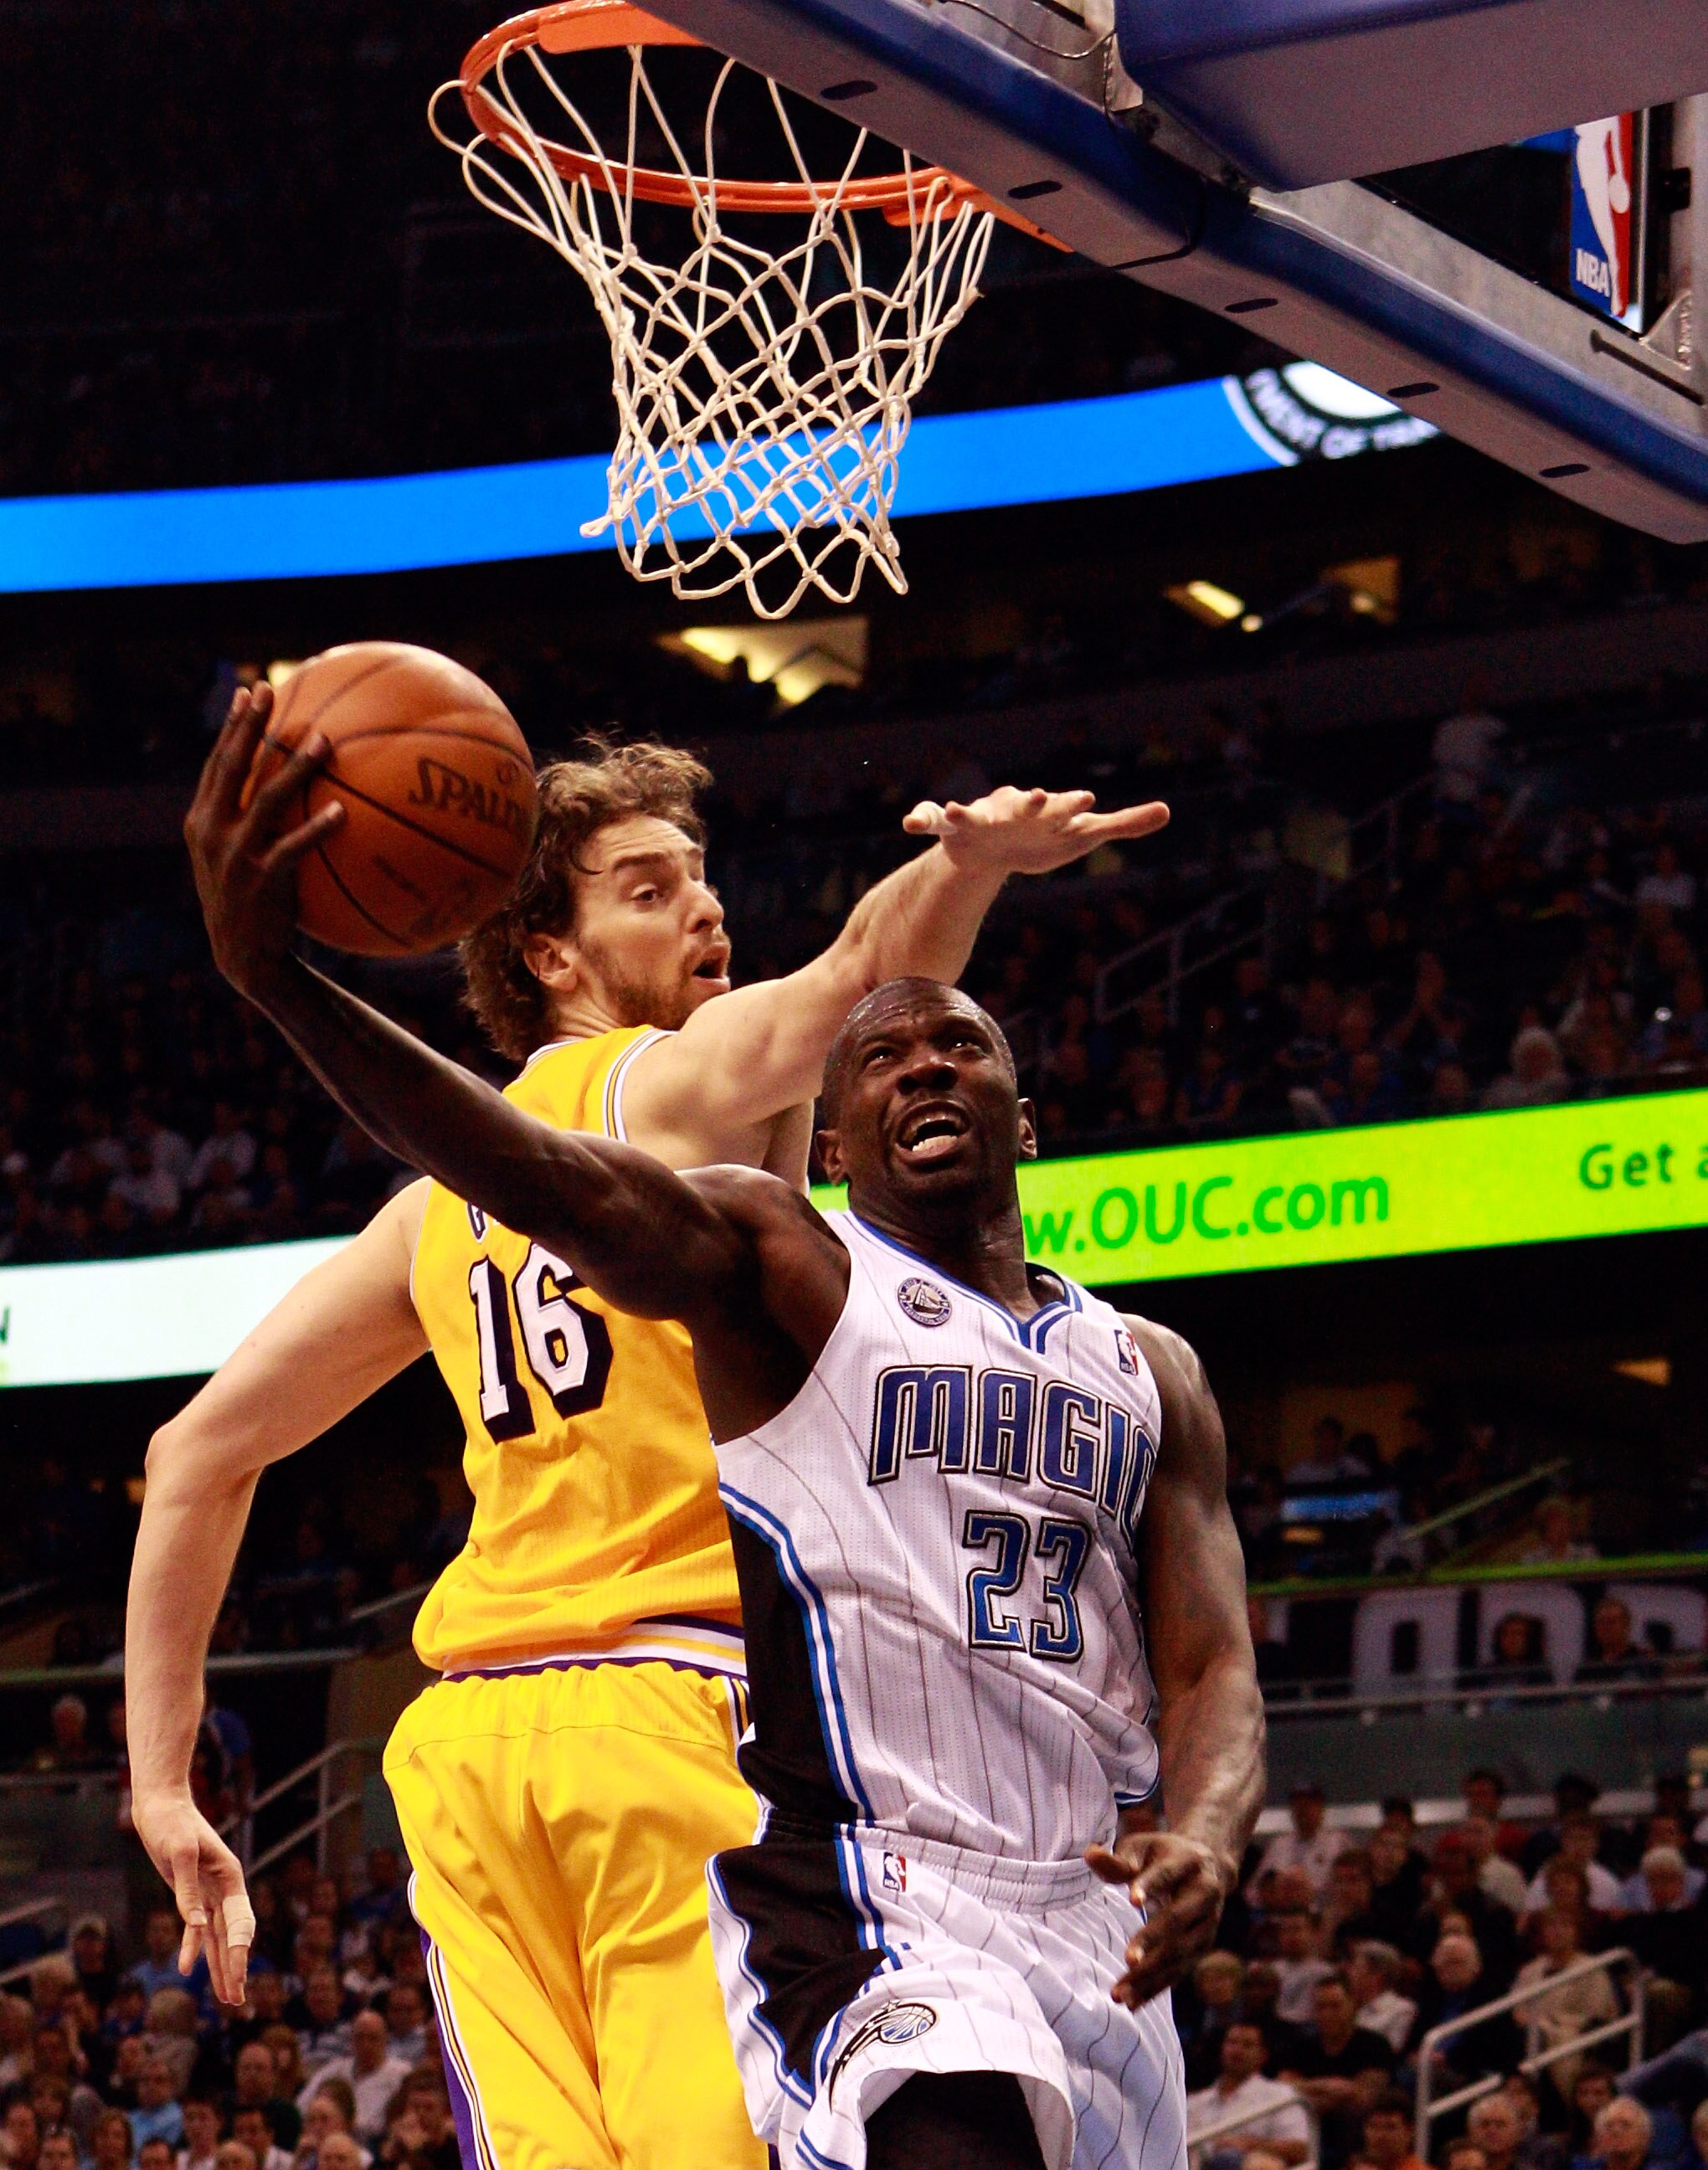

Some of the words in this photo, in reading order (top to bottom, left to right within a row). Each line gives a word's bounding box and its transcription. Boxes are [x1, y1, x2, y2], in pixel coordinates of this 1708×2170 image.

[1575, 247, 1610, 297] NBA
[1579, 1143, 1673, 1190] Get
[1023, 1176, 1389, 1255] w.OUC.com
[468, 1241, 615, 1445] 16
[963, 1509, 1089, 1664] 23
